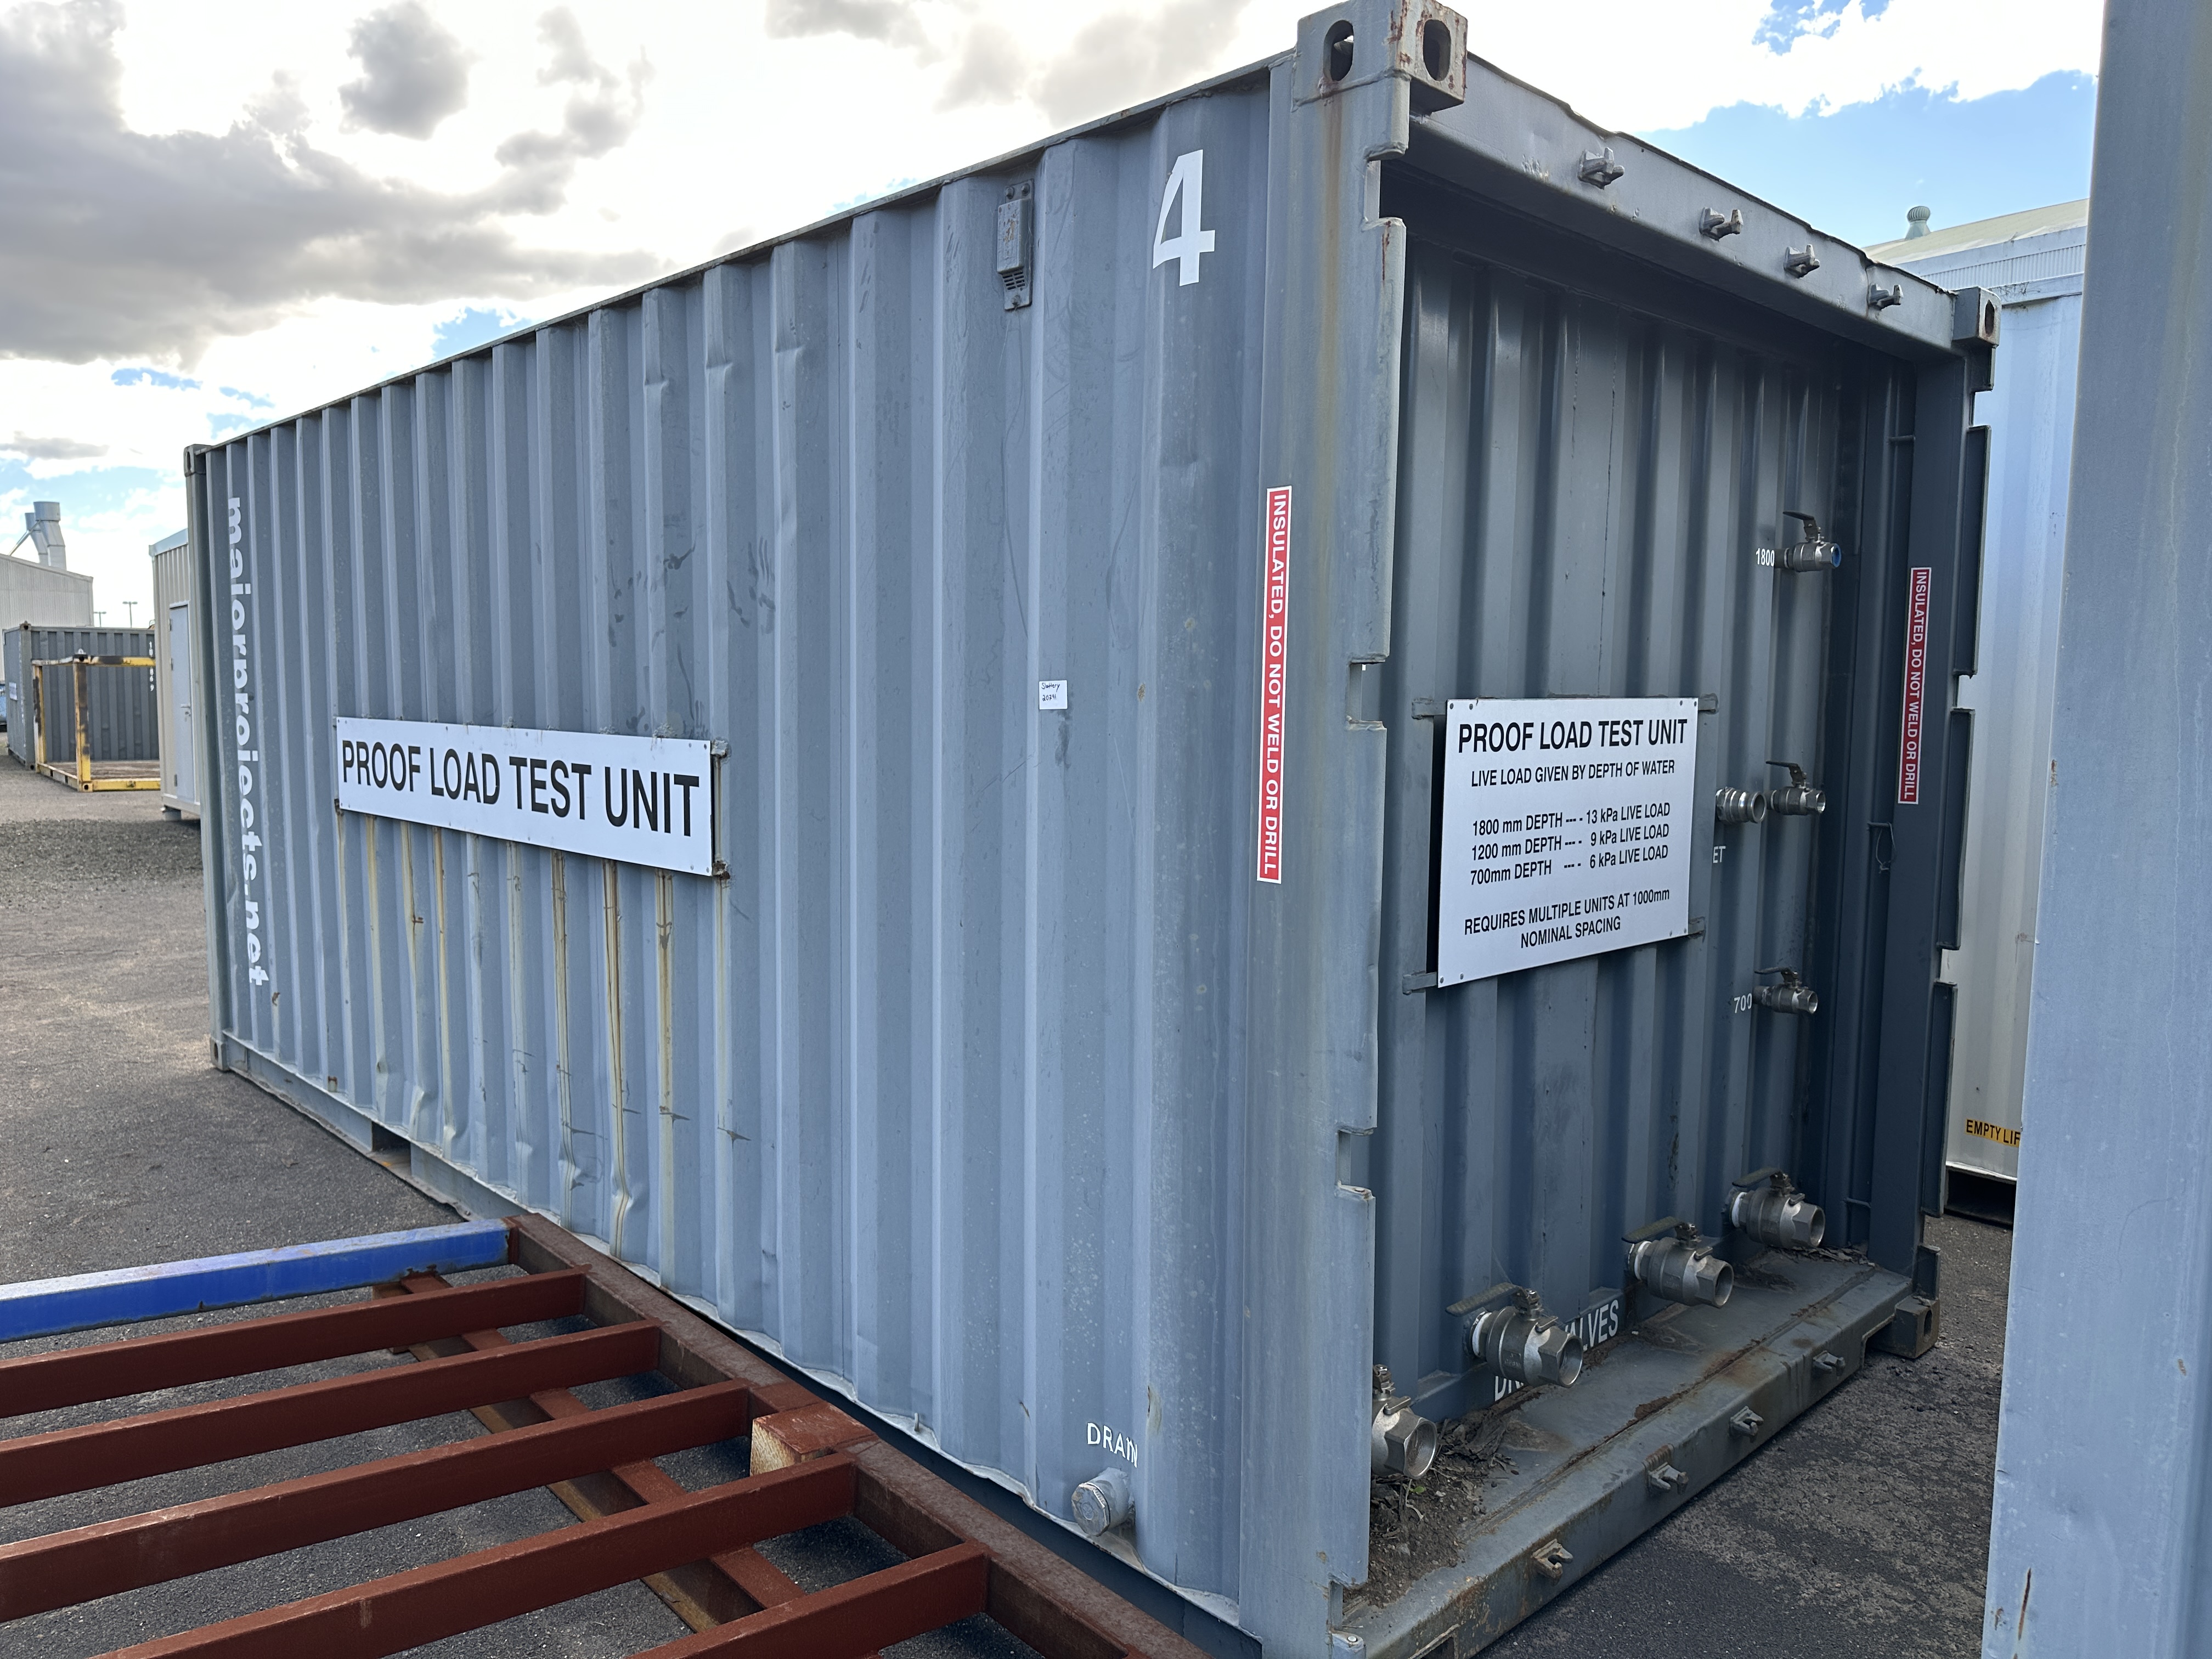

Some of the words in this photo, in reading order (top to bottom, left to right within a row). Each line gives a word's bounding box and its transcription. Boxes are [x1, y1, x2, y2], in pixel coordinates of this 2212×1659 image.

[1153, 149, 1215, 286] 4
[1268, 494, 1287, 619] INSULATED,
[1756, 548, 1775, 566] 1800
[1910, 571, 1927, 645] INSULATED,
[1268, 626, 1283, 657] DO
[1911, 649, 1921, 668] DO
[1267, 664, 1282, 709] NOT
[1909, 672, 1920, 698] NOT
[1459, 723, 1534, 753] PROOF
[1539, 721, 1592, 750] LOAD
[1598, 720, 1644, 747] TEST
[1647, 719, 1688, 745] UNIT
[1906, 701, 1918, 738] WELD
[1266, 714, 1280, 774] WELD
[1905, 741, 1916, 760] OR
[342, 740, 421, 792] PROOF
[430, 748, 500, 805] LOAD
[509, 756, 592, 820] TEST
[605, 766, 699, 837] UNIT
[1471, 770, 1497, 787] LIVE
[1500, 768, 1532, 785] LOAD
[1535, 766, 1568, 783] GIVEN
[1572, 765, 1585, 780] BY
[1588, 763, 1623, 779] DEPTH
[1625, 761, 1639, 776] OF
[1641, 759, 1675, 775] WATER
[1904, 763, 1915, 799] DRILL
[1265, 779, 1279, 810] OR
[1473, 820, 1499, 836] 1800
[1503, 821, 1522, 833] mm
[1526, 812, 1562, 831] DEPTH
[1586, 809, 1598, 825] 13
[1600, 807, 1618, 823] kPa
[1621, 804, 1642, 821] LIVE
[1644, 802, 1671, 818] LOAD
[1263, 816, 1278, 874] DRILL
[1472, 844, 1498, 861] 1200
[1502, 845, 1521, 857] mm
[1525, 835, 1562, 854] DEPTH
[1590, 832, 1596, 846] 9
[1599, 829, 1617, 845] kPa
[1620, 826, 1641, 843] LIVE
[1643, 823, 1669, 840] LOAD
[1470, 867, 1511, 885] 700mm
[1514, 859, 1552, 879] DEPTH
[1589, 855, 1595, 869] 6
[1598, 851, 1616, 867] kPa
[1619, 847, 1640, 864] LIVE
[1643, 844, 1668, 861] LOAD
[1465, 910, 1525, 935] REQUIRES
[1528, 900, 1581, 924] MULTIPLE
[1584, 895, 1615, 914] UNITS
[1617, 892, 1630, 908] AT
[1633, 888, 1670, 905] 1000mm
[1521, 926, 1572, 949] NOMINAL
[1575, 916, 1621, 938] SPACING
[1734, 993, 1752, 1013] 700
[1966, 1119, 2001, 1141] EMPTY
[2004, 1129, 2021, 1145] LIF
[1087, 1422, 1138, 1468] DRAIN
